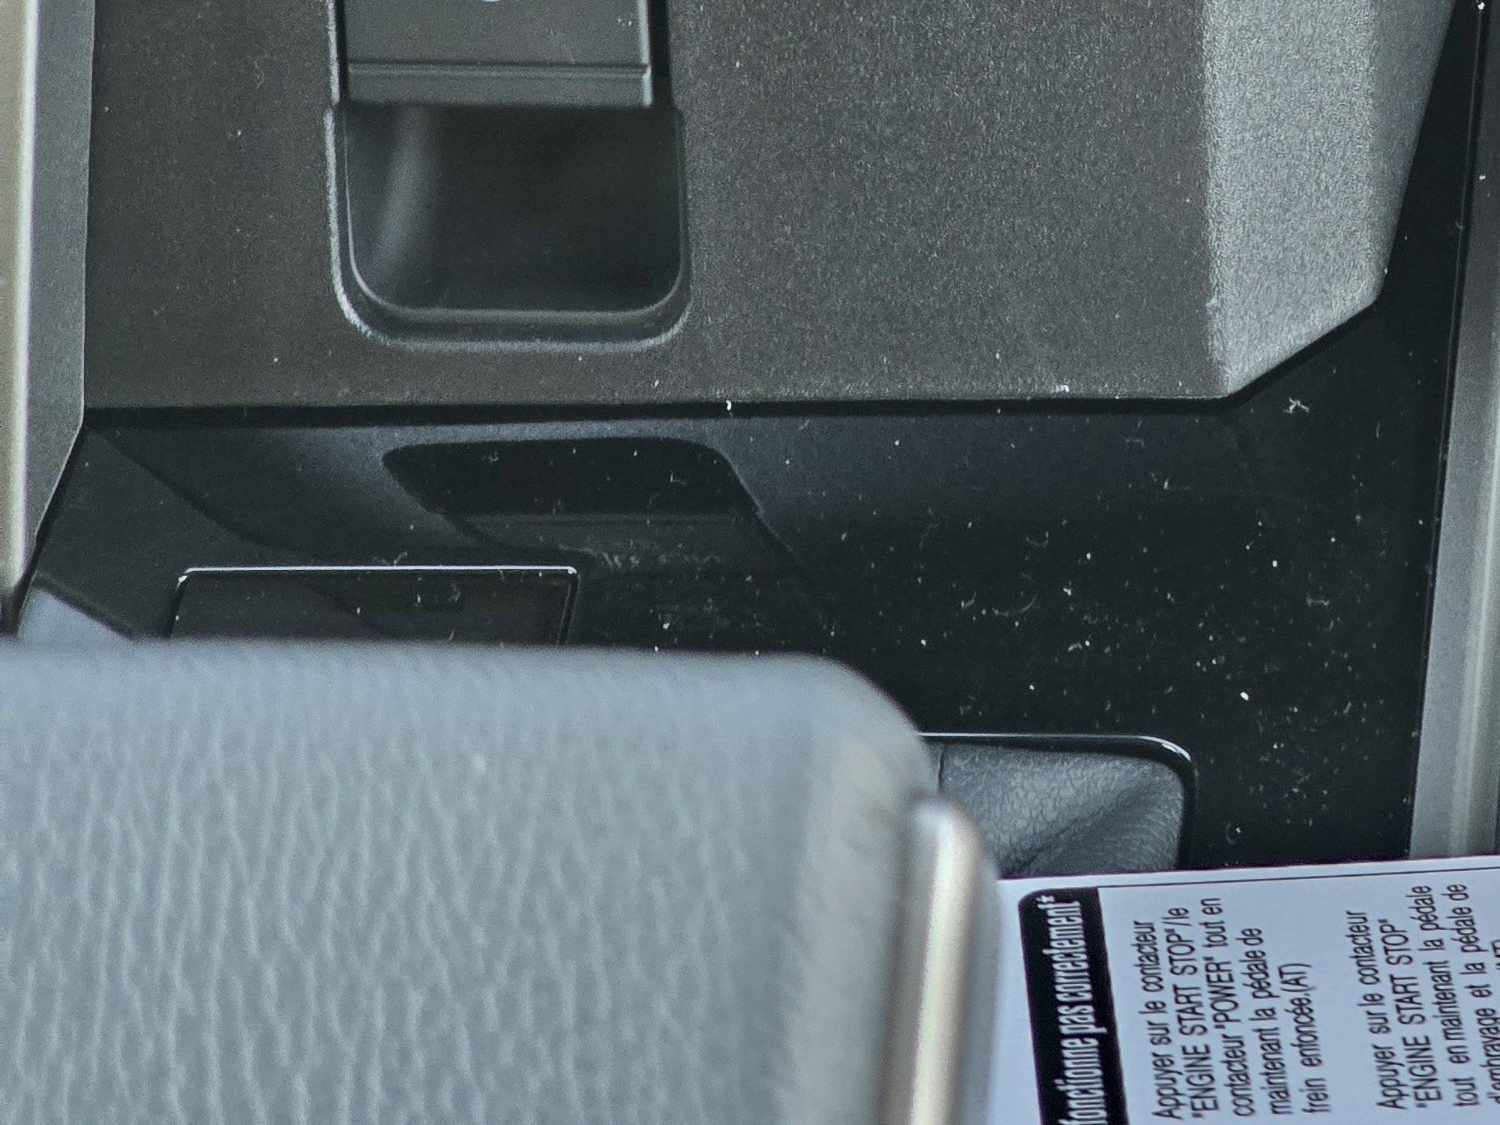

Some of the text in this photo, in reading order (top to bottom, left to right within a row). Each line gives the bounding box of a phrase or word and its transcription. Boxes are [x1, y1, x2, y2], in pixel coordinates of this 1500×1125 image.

[1442, 884, 1467, 901] de
[1450, 905, 1488, 952] pédale
[1406, 885, 1480, 1107] tout en maintenant la pédale
[1459, 961, 1487, 975] la
[1465, 983, 1493, 998] et
[1056, 1004, 1107, 1036] pas
[1133, 921, 1187, 1121] Appuyer sur le contacteur
[1173, 983, 1208, 1036] START
[1199, 897, 1254, 1117] contacteur "POWER" tout en
[1235, 928, 1293, 1115] maintenant la pédale de
[1346, 911, 1406, 1109] Appuyer sur le contacteur
[1378, 919, 1442, 1108] "ENGINE START STOP"
[1054, 1037, 1108, 1125] fonctionne
[1182, 1044, 1219, 1119] "ENGINE
[1297, 1078, 1331, 1113] frein
